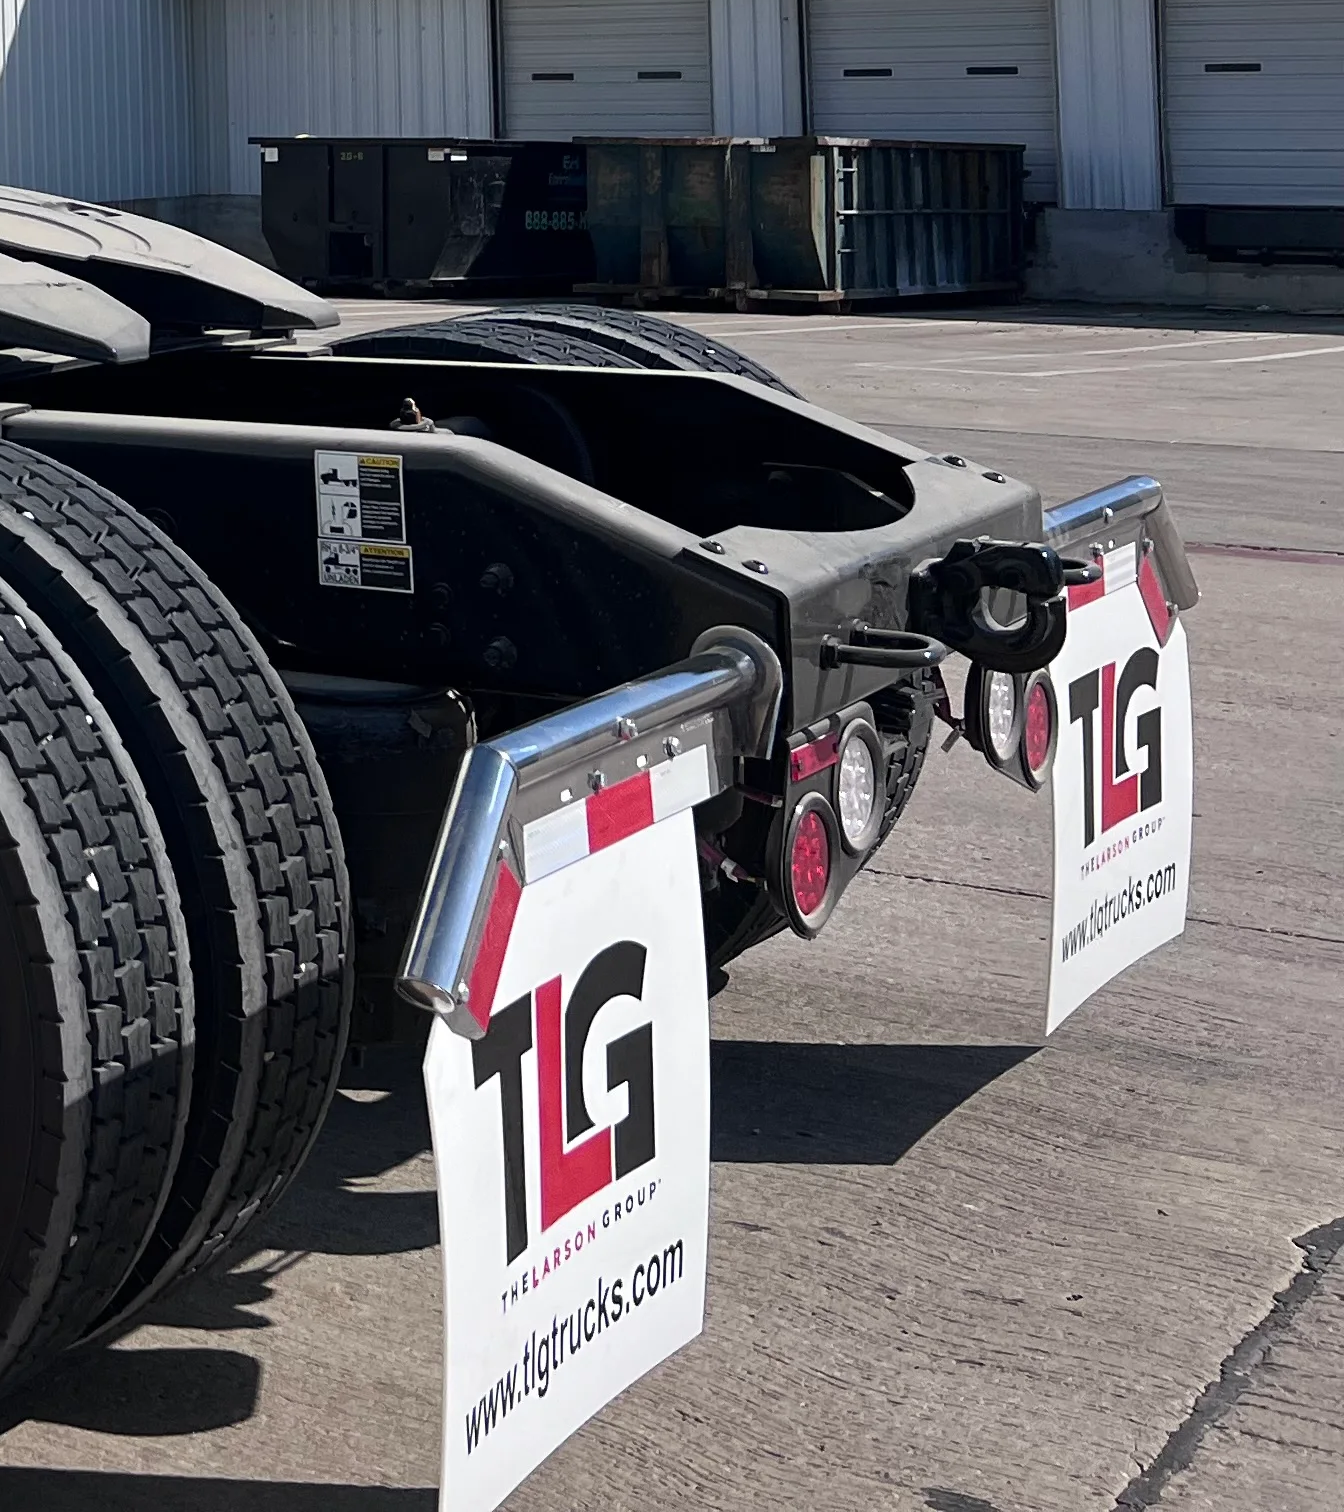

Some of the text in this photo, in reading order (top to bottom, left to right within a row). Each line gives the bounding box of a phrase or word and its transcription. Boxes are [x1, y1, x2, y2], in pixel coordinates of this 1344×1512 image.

[364, 546, 405, 557] ATTENTION
[1068, 646, 1162, 849] TLG
[1062, 861, 1177, 963] www.tlgtrucks.com
[471, 939, 656, 1267] TLG
[602, 1181, 657, 1229] GROUP
[465, 1238, 684, 1456] www.tlgtrucks.com
